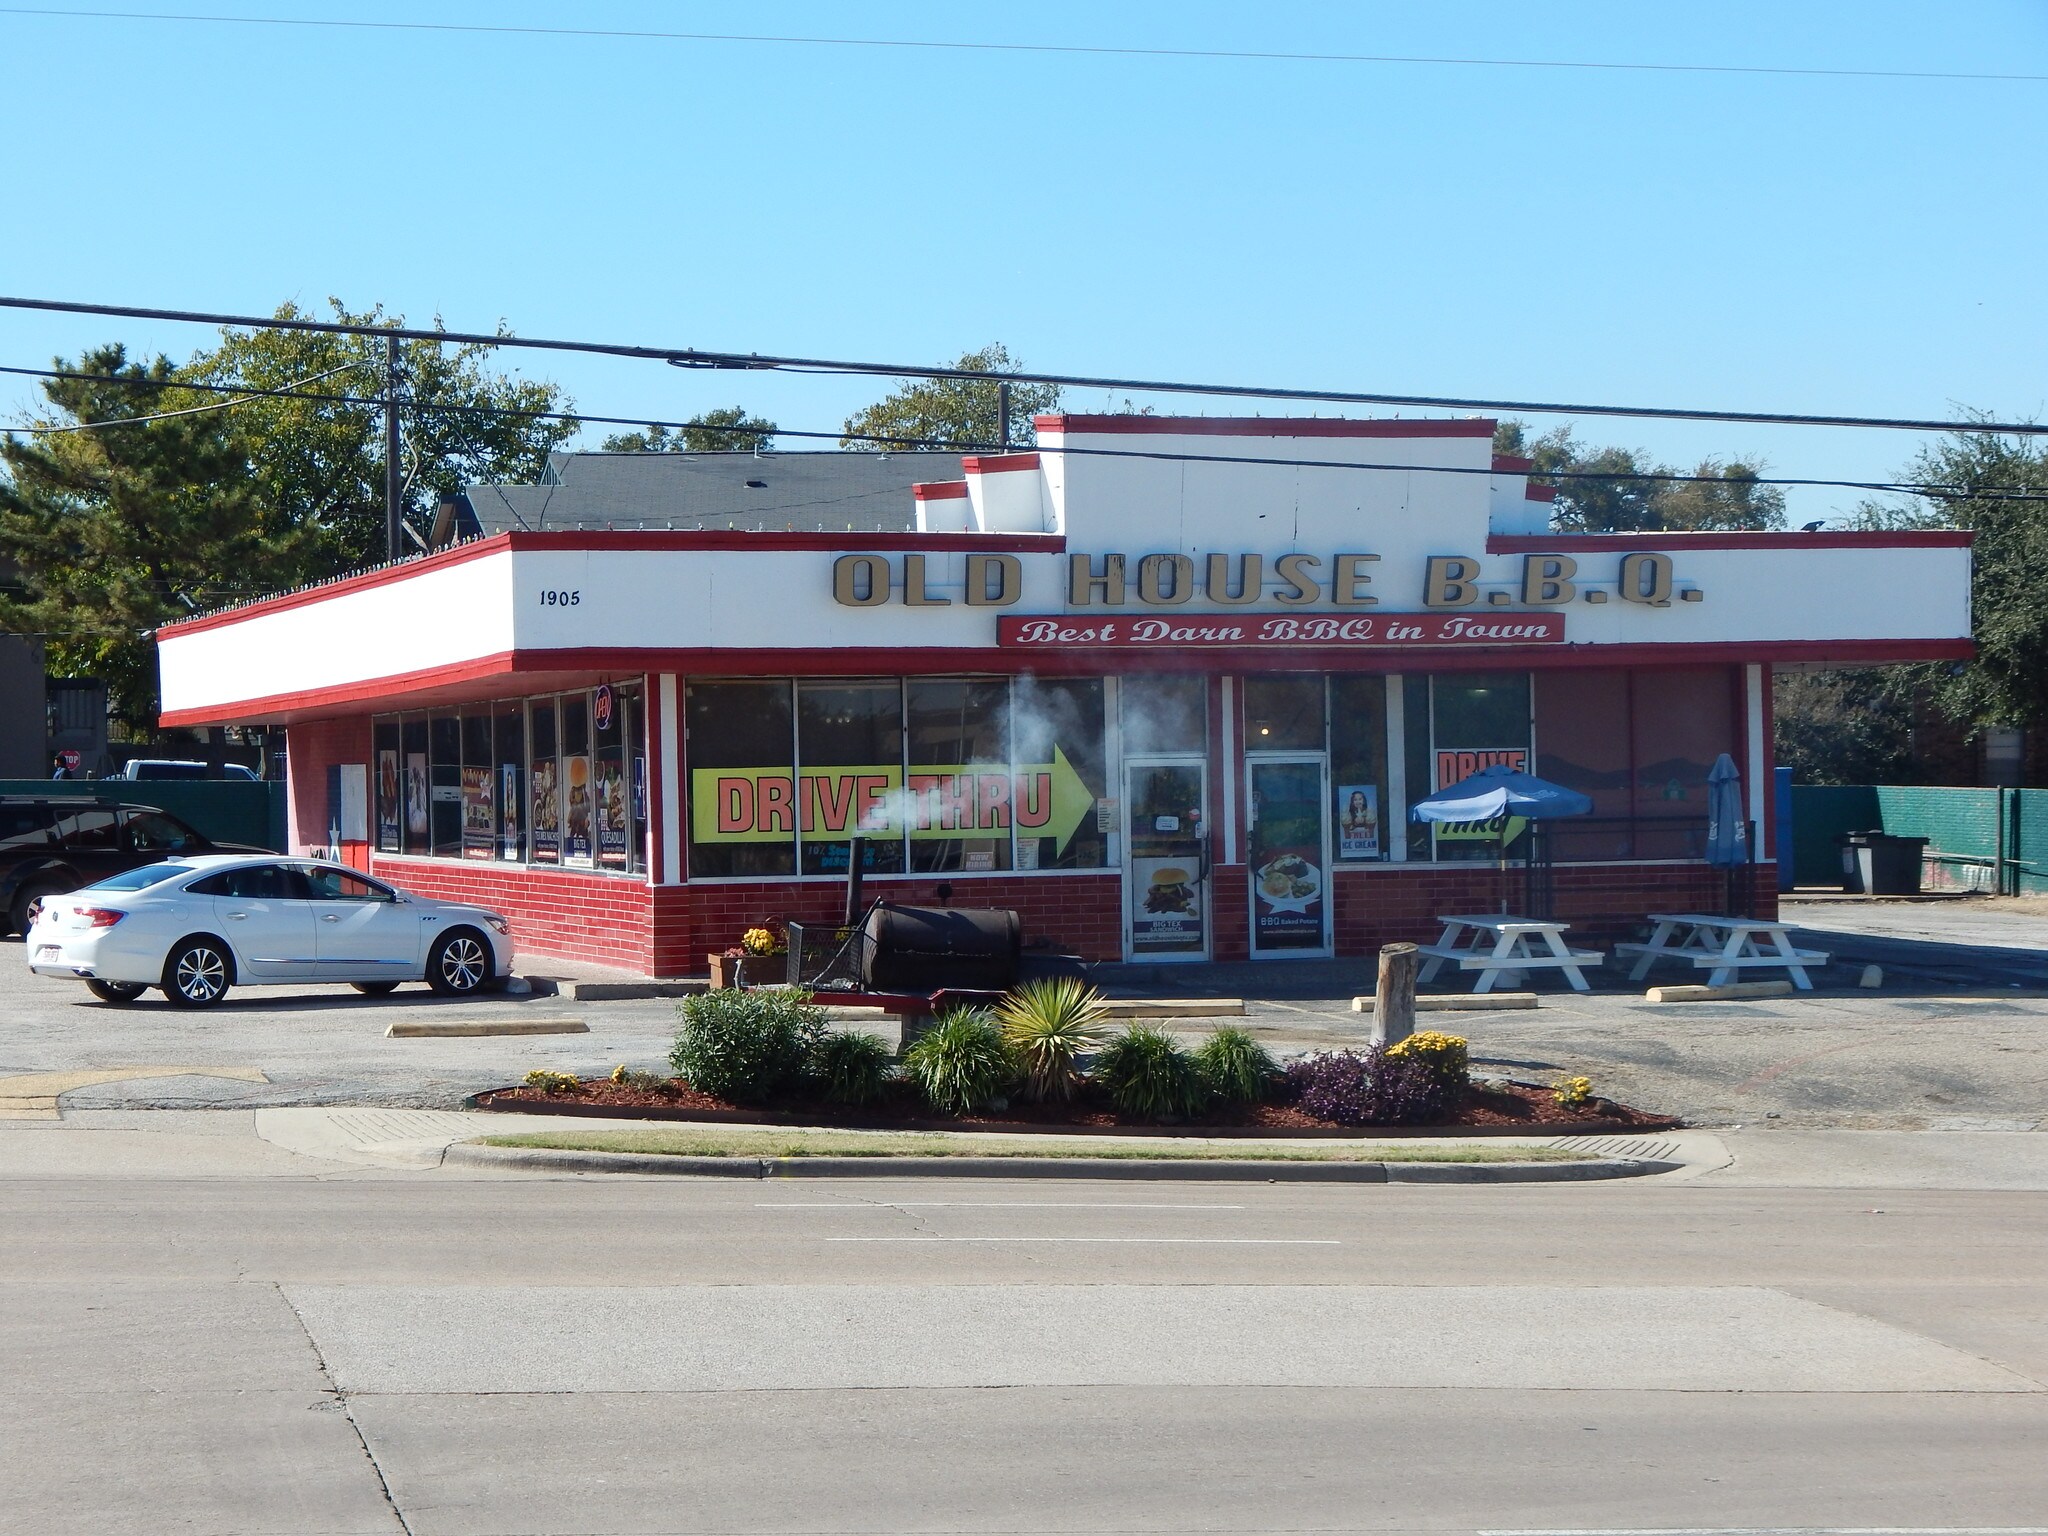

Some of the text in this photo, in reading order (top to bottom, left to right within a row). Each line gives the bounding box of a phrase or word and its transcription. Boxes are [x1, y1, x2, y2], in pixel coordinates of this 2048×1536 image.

[833, 552, 1703, 607] OLD HOUSE B.B.Q.
[540, 590, 580, 606] 1905
[1016, 617, 1551, 643] Best Darn BBQ in Town
[65, 755, 79, 764] TOP
[718, 775, 889, 833] DRIVE
[908, 773, 1051, 831] THRU
[600, 831, 625, 844] QUESADILLA
[1342, 840, 1377, 849] ICE CREAM
[1260, 917, 1280, 926] BBQ
